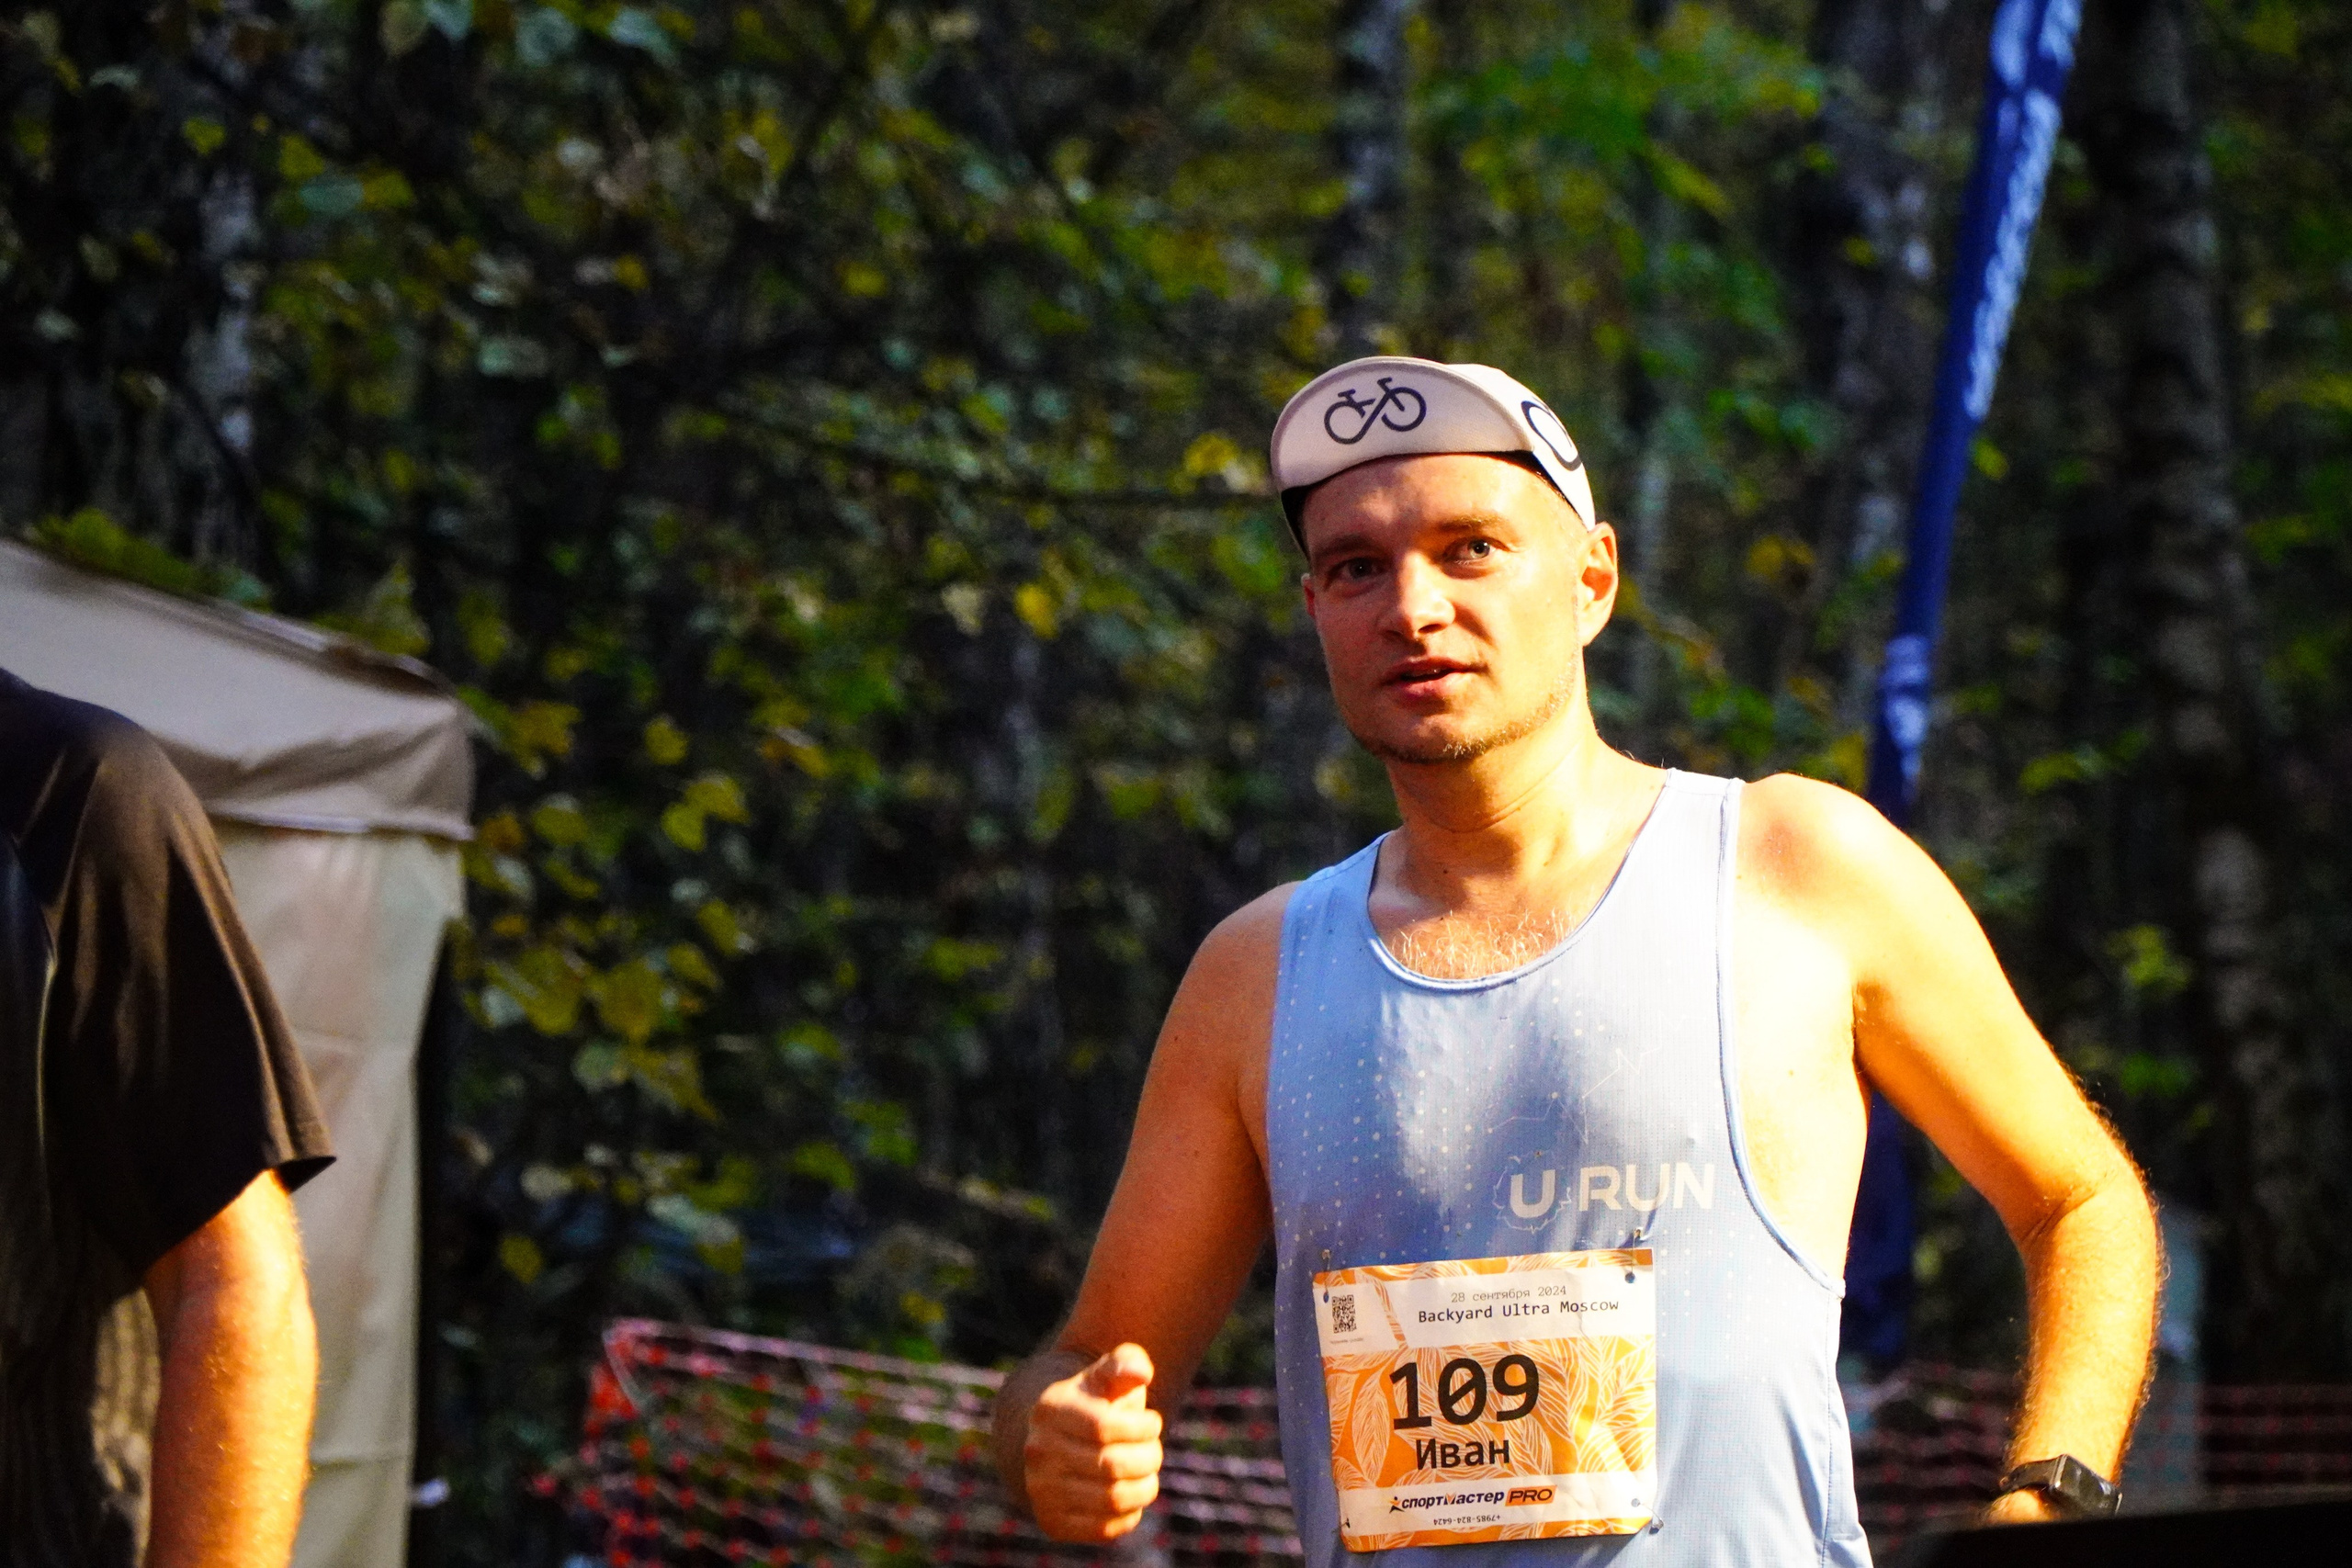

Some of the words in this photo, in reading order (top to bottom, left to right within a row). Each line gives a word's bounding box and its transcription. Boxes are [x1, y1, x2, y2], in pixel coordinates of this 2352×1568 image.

[1510, 1169, 1555, 1218] U
[1578, 1162, 1715, 1212] RUN
[1451, 1292, 1465, 1303] 28
[1472, 1287, 1531, 1302] сентября
[1538, 1285, 1567, 1297] 2024
[1419, 1304, 1493, 1324] Backyard
[1502, 1303, 1550, 1317] Ultra
[1560, 1301, 1619, 1314] Moscow
[1389, 1354, 1540, 1430] 109
[1416, 1438, 1510, 1471] Иван
[1509, 1488, 1554, 1504] PRO
